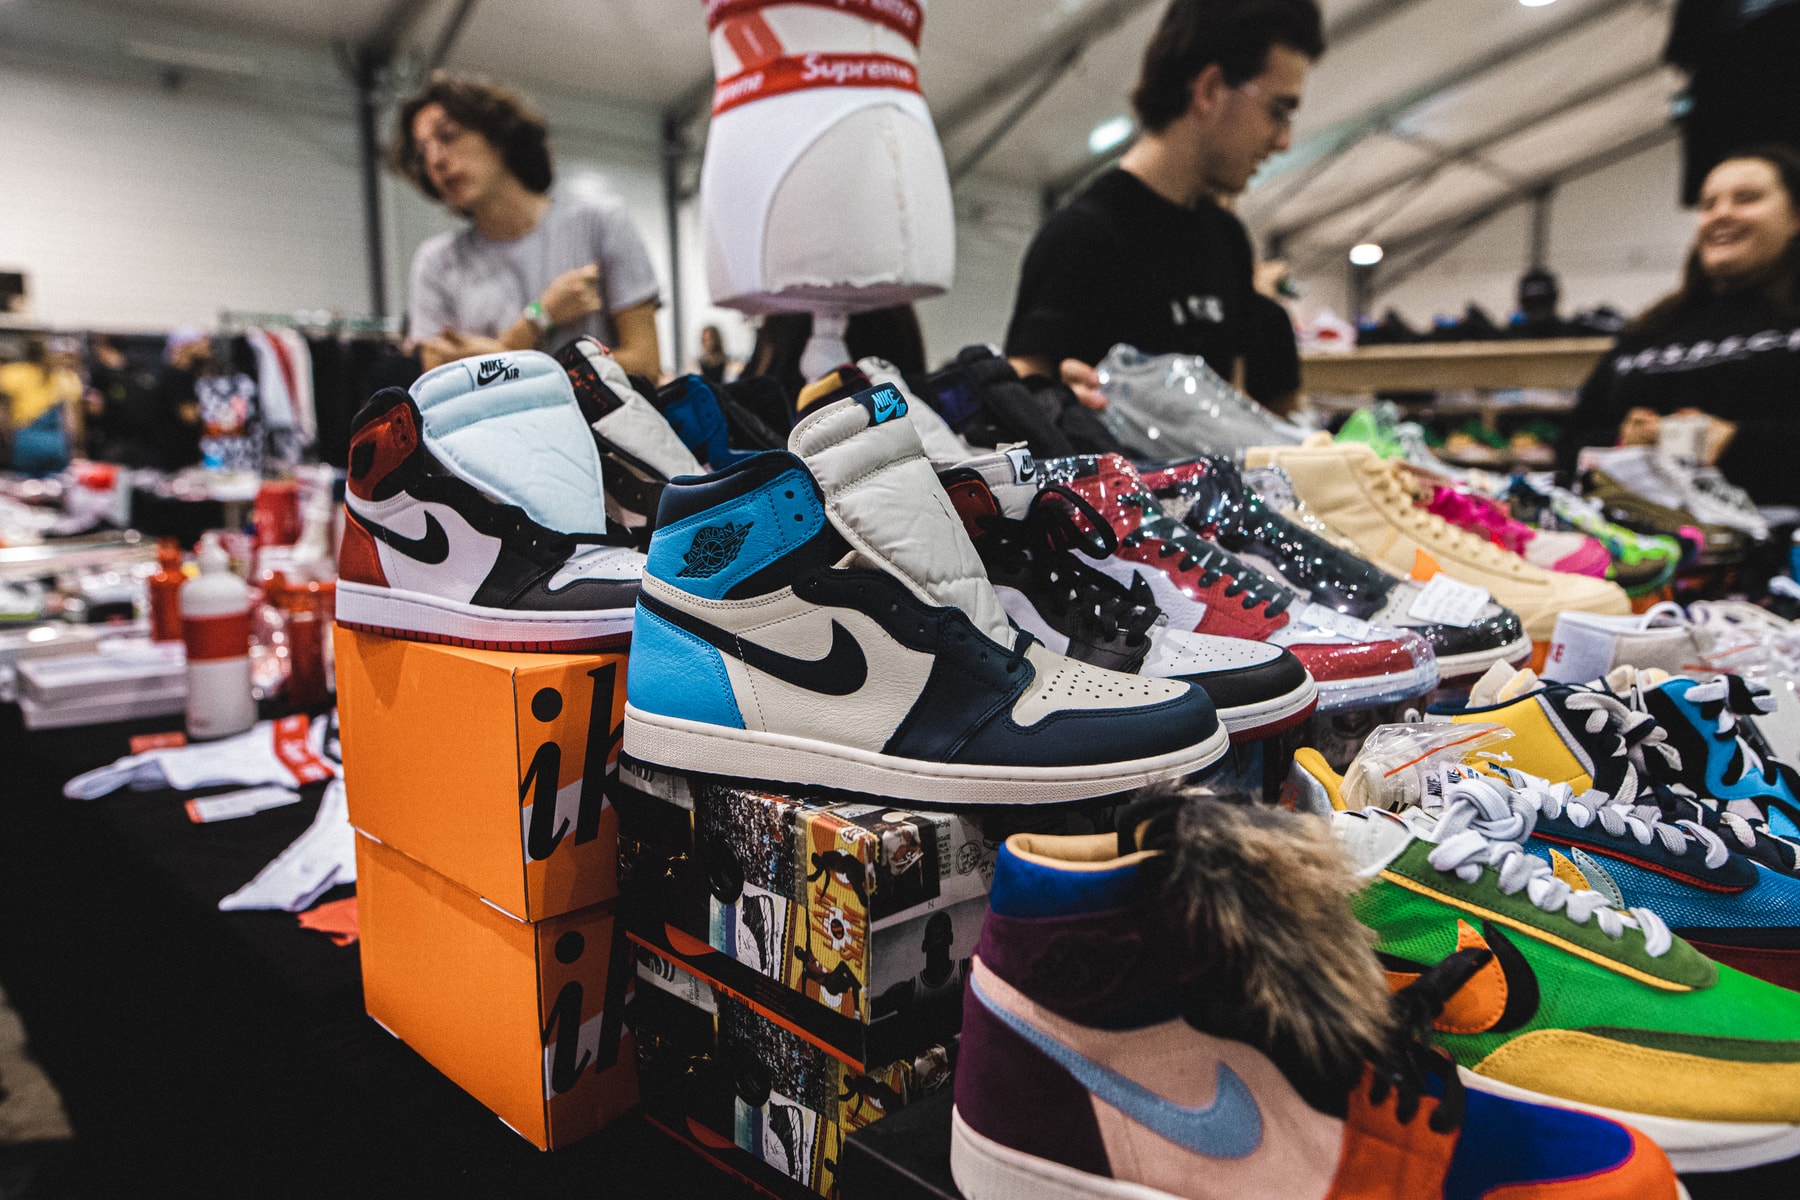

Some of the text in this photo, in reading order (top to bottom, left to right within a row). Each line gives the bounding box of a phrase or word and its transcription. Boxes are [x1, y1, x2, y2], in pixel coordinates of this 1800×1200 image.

[802, 53, 914, 84] Supreme
[480, 359, 503, 374] NIKE
[503, 368, 519, 381] AIR
[871, 388, 894, 408] NIKE
[688, 526, 733, 562] AIR JORDAN
[812, 885, 837, 950] JAM
[840, 903, 867, 969] SLAM
